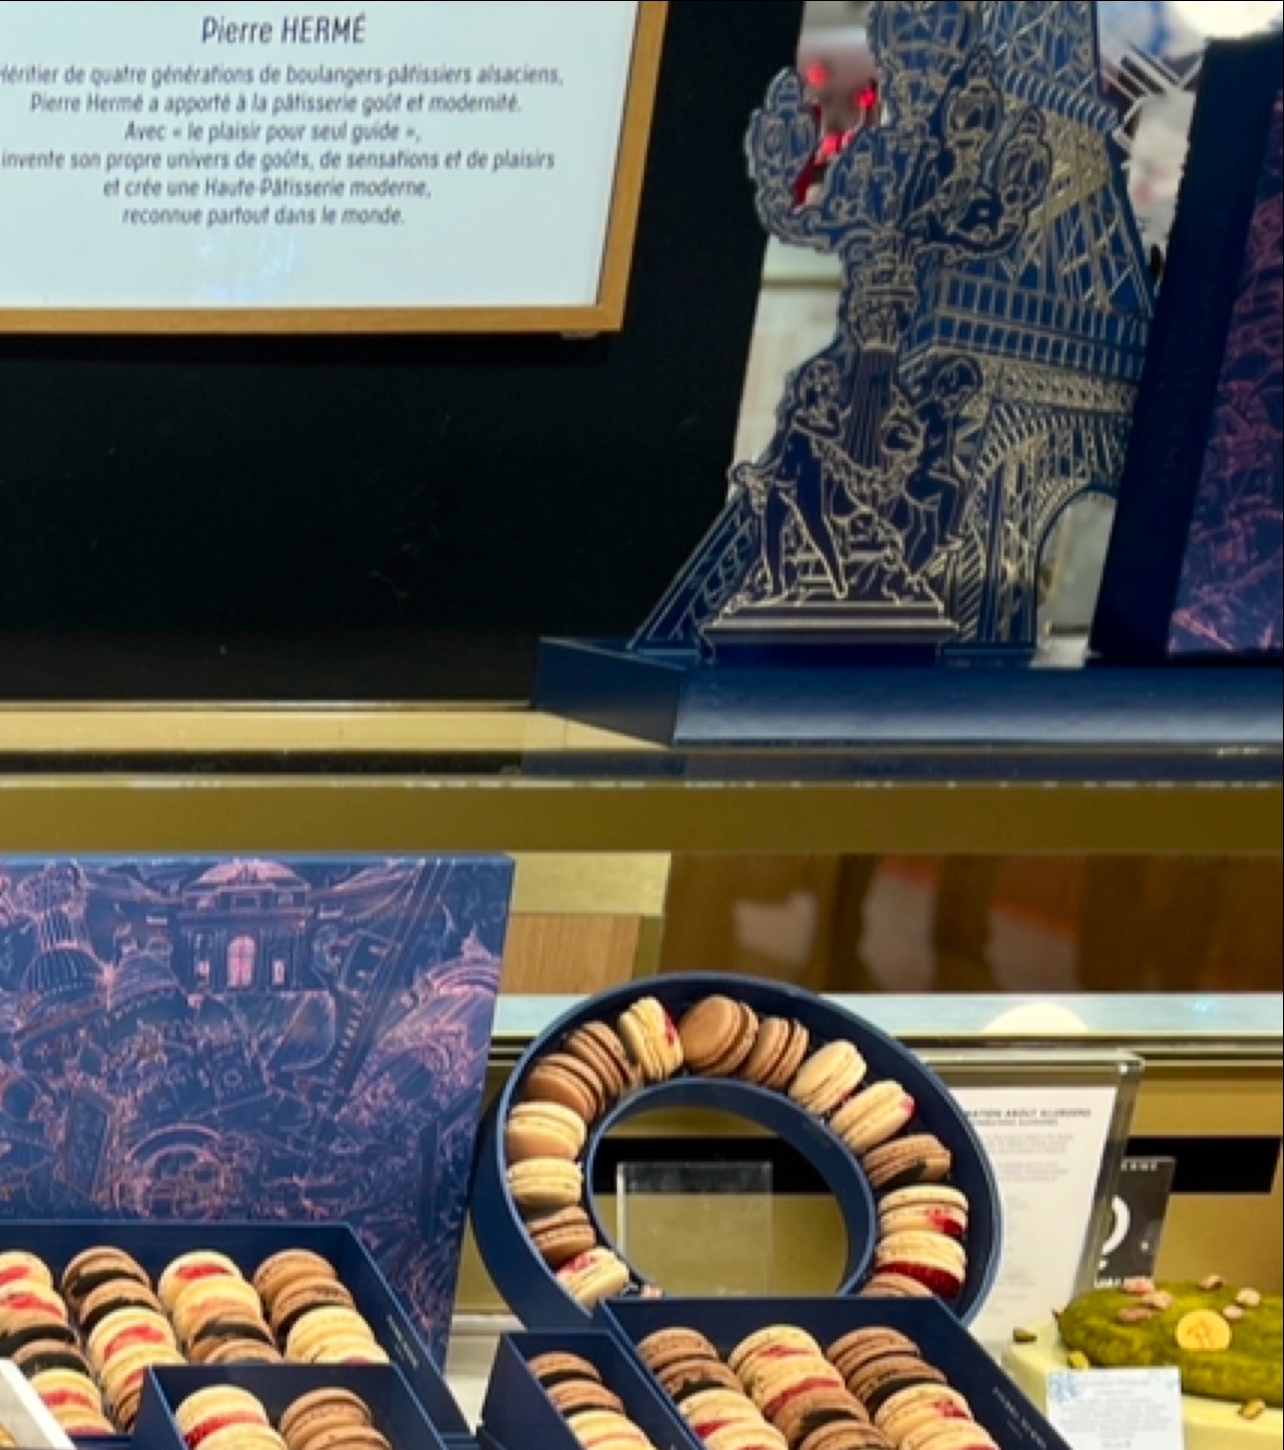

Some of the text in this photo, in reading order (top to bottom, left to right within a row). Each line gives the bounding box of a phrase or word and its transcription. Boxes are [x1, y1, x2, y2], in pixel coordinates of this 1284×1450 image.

[201, 13, 366, 44] Pierre HERMÉ
[64, 64, 86, 84] de
[90, 64, 146, 88] quatre
[151, 64, 254, 88] générations
[259, 64, 281, 84] de
[476, 64, 563, 88] alsaciens,
[30, 92, 81, 113] Pierre
[86, 92, 143, 113] Hermé
[164, 92, 231, 117] apporté
[251, 92, 267, 113] la
[271, 92, 356, 117] pâtisserie
[361, 92, 401, 117] goût
[407, 92, 423, 113] et
[428, 92, 521, 113] modernité.
[124, 121, 167, 141] Avec
[188, 121, 203, 141] le
[208, 121, 261, 145] plaisir
[266, 121, 306, 145] pour
[311, 121, 347, 141] seul
[352, 121, 399, 145] guide
[2, 149, 65, 169] invente
[71, 153, 101, 169] son
[106, 149, 162, 173] propre
[167, 149, 230, 169] univers
[235, 149, 256, 169] de
[261, 149, 314, 173] goûts,
[319, 149, 341, 169] de
[347, 149, 439, 169] sensations
[445, 149, 462, 169] et
[467, 149, 488, 169] de
[492, 149, 555, 173] plaisirs
[103, 177, 120, 198] et
[125, 177, 162, 198] crée
[167, 181, 200, 198] une
[350, 177, 431, 200] moderne,
[122, 205, 404, 230] reconnue partout dans le monde.
